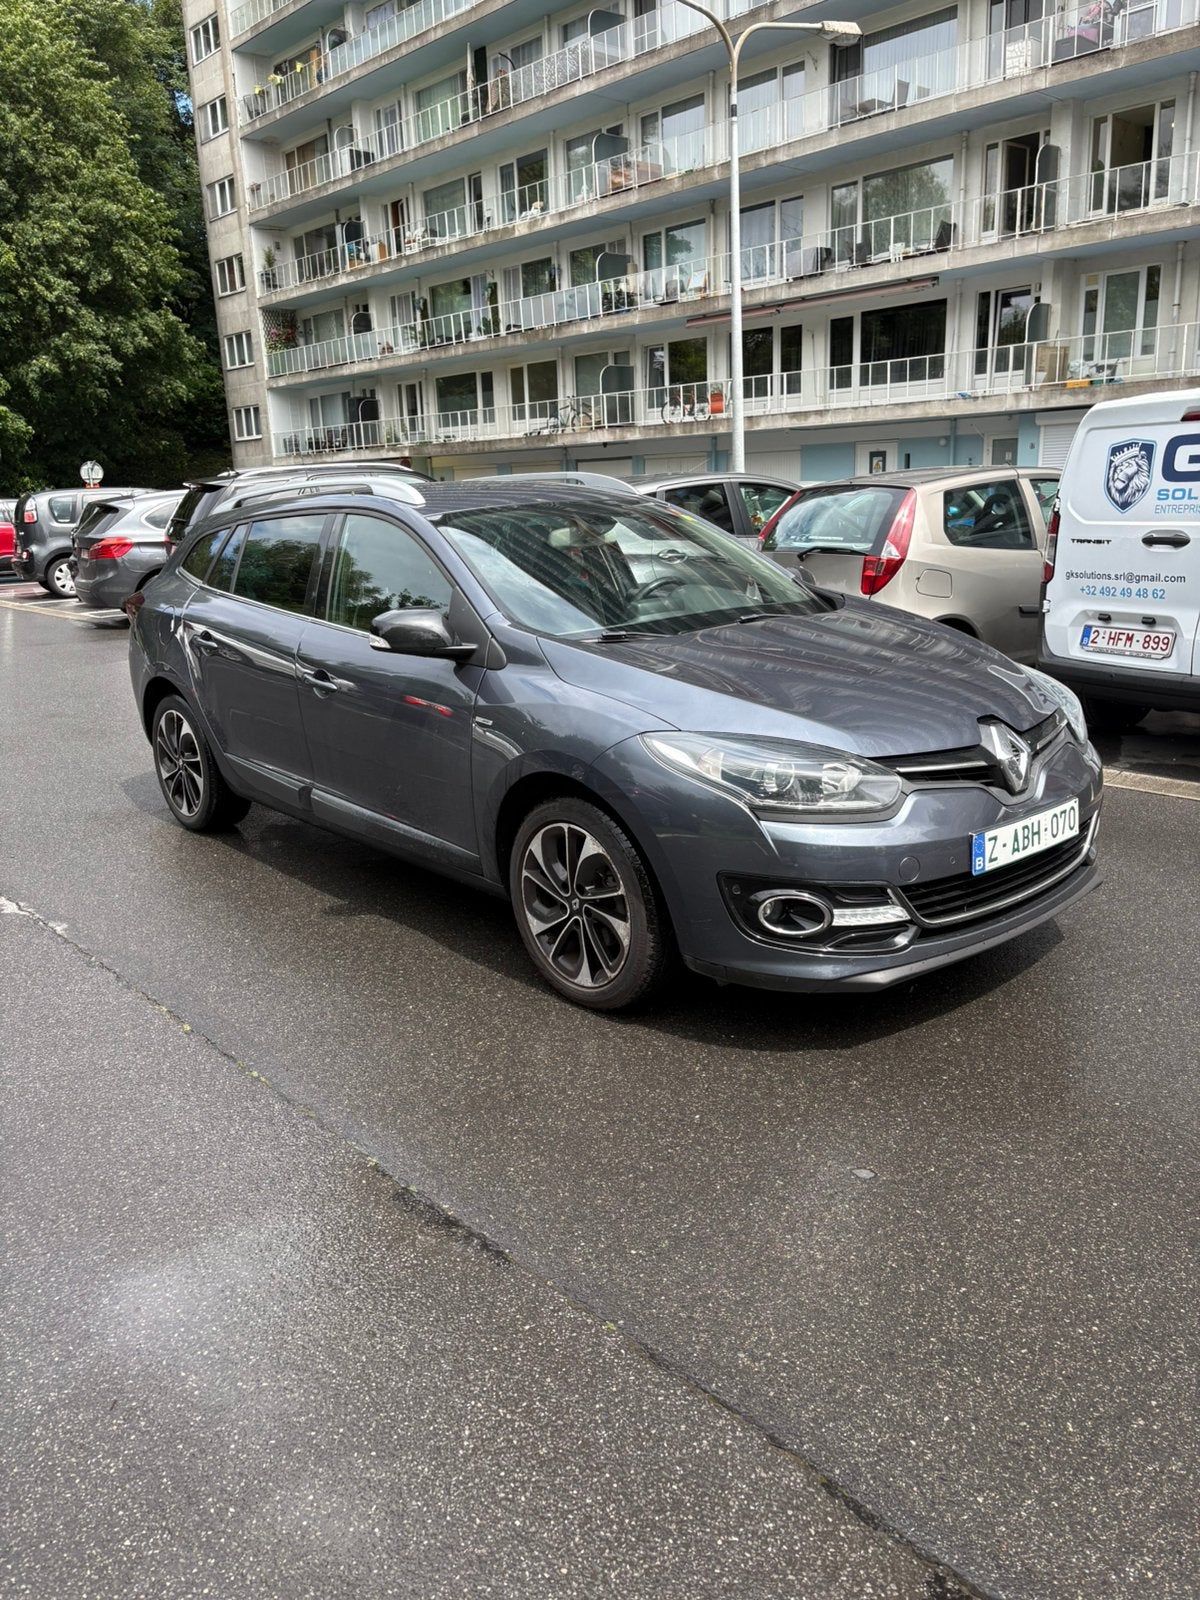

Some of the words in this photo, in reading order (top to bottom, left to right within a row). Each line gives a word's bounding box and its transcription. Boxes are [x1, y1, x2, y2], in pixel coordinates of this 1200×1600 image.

[1065, 570, 1187, 584] gksolutions.srl@gmail.com
[1079, 585, 1097, 596] +32
[1099, 586, 1118, 597] 492
[1119, 587, 1133, 598] 49
[1135, 588, 1149, 599] 48
[1151, 588, 1166, 600] 62
[1090, 629, 1170, 652] 2-HFM-899
[975, 857, 984, 871] B
[987, 805, 1077, 864] Z-ABH-070
